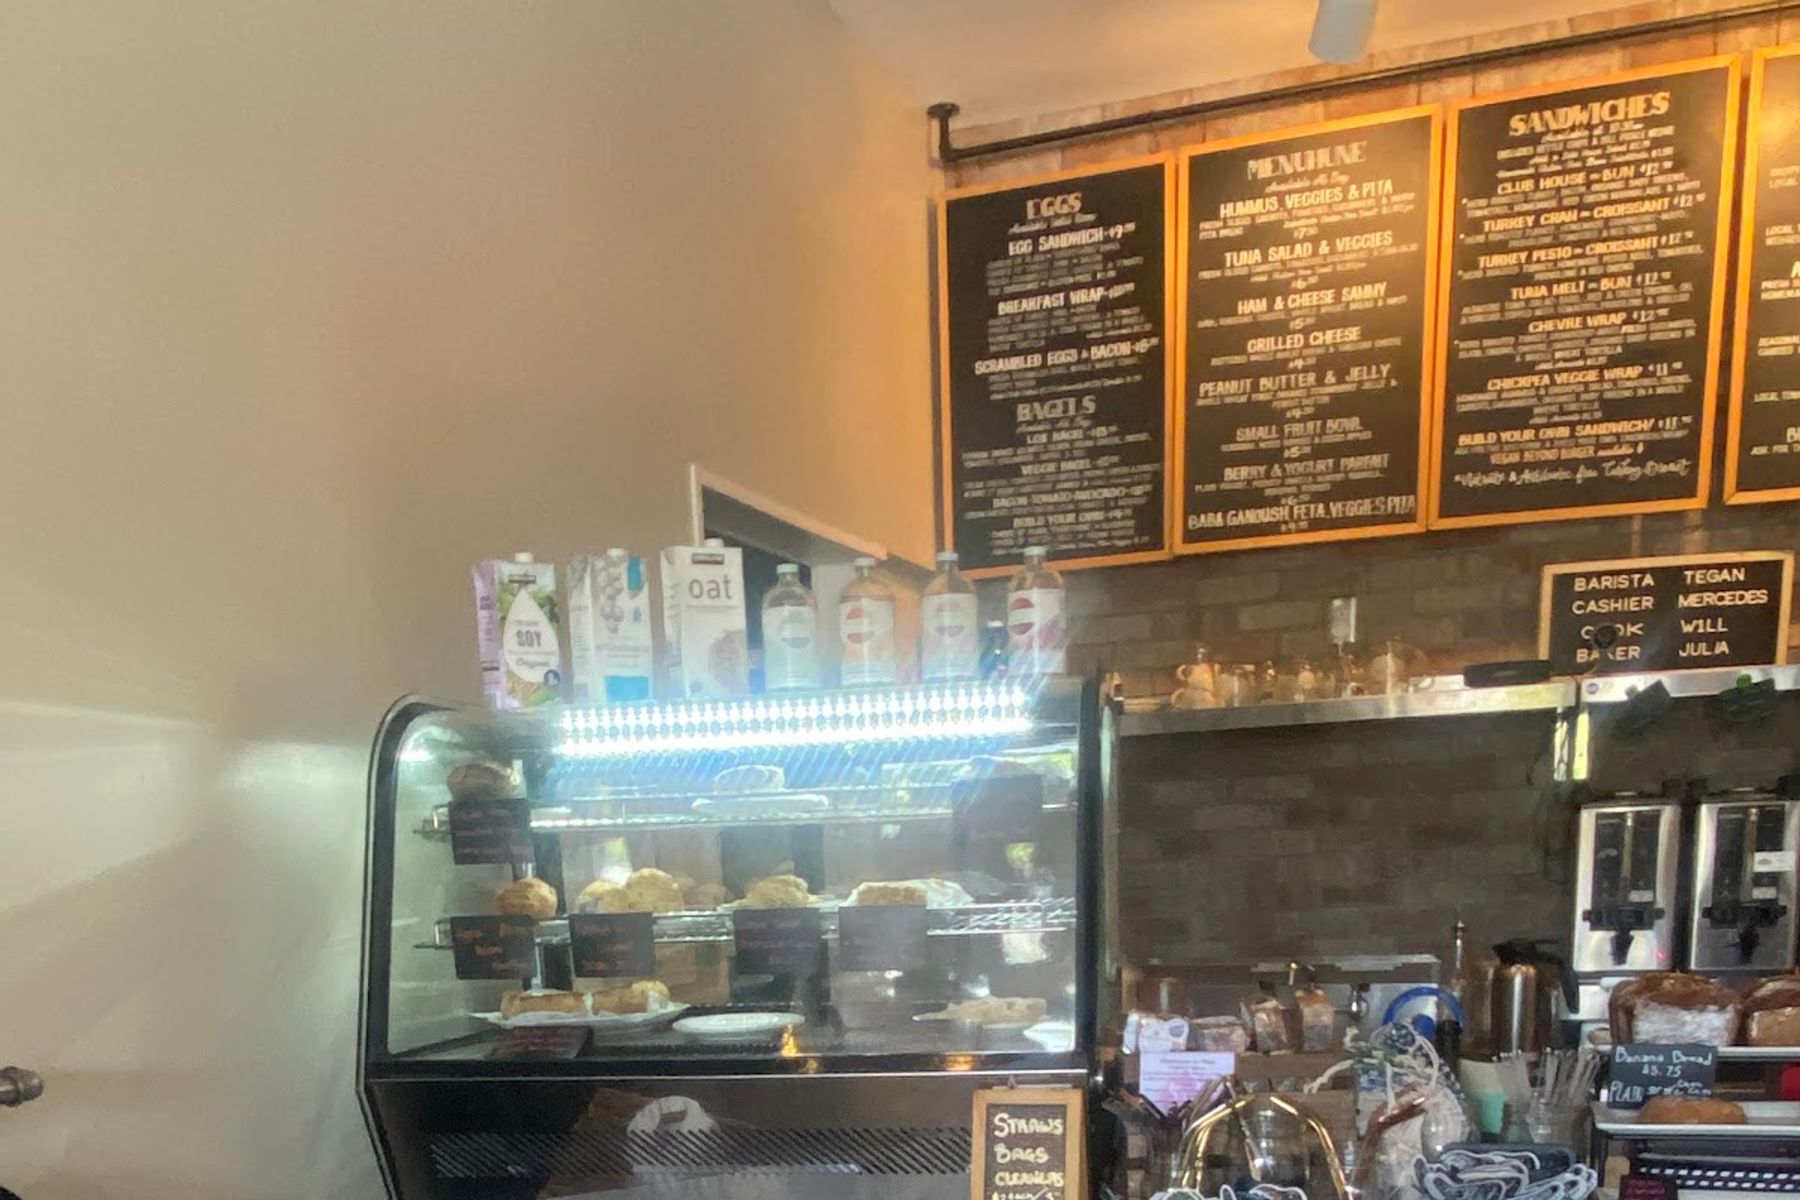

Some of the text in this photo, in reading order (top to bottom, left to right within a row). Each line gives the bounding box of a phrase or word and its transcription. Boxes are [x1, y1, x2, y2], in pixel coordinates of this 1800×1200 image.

[1508, 91, 1671, 137] SANDWICHES
[1285, 185, 1343, 208] VEGGIES
[1348, 184, 1360, 199] &
[1362, 179, 1393, 197] PITA
[1497, 165, 1635, 195] CLUB HOUSE BUN
[1025, 192, 1083, 220] EGGS
[1483, 213, 1536, 232] TURKEY
[1540, 209, 1578, 226] CRAN
[1594, 197, 1670, 219] CROISSANT
[1008, 226, 1104, 256] EGG SANDWICH
[1224, 248, 1262, 267] TUNA
[1268, 242, 1312, 262] SALAD
[1318, 240, 1331, 255] &
[1336, 231, 1393, 252] VEGGIES
[1478, 250, 1528, 269] TURKEY
[1532, 245, 1572, 263] PESTO
[1585, 236, 1659, 256] CROISSANT
[998, 286, 1104, 316] BREAKFAST WRAP
[1237, 297, 1267, 315] HAM
[1274, 296, 1284, 311] &
[1287, 289, 1336, 309] CHEESE
[1341, 282, 1387, 302] SAMMY
[1511, 275, 1633, 300] TUNA MELT BUN
[1528, 312, 1627, 333] CHEVRE WRAP
[1247, 332, 1304, 354] GRILLED
[1309, 326, 1362, 346] CHEESE
[974, 353, 1043, 376] SCRAMBLED
[1047, 348, 1078, 367] EGGS
[1090, 340, 1132, 361] BACON
[1200, 363, 1392, 397] PEANUT BUTTER & JELLY
[1487, 365, 1643, 391] CHICKPEA VEGGIE WRAP
[1016, 394, 1097, 423] BAGELS
[1236, 424, 1279, 442] SMALL
[1284, 420, 1323, 438] FRUIT
[1326, 416, 1364, 434] BOWL
[1458, 432, 1498, 447] BUILD
[1500, 428, 1535, 443] YOUR
[1539, 425, 1570, 439] OWN
[1223, 453, 1390, 482] BERRY & YOGURT PARFAIT
[1187, 511, 1223, 531] BABA
[688, 576, 732, 601] oat
[1573, 567, 1747, 593] BARISTA TEGAN
[1571, 589, 1770, 615] CASHIER MERCEDES
[515, 629, 542, 648] SOY
[1580, 617, 1730, 641] COK WILL
[1575, 640, 1731, 664] BAER JULIA
[1615, 1045, 1713, 1066] Banana Bread
